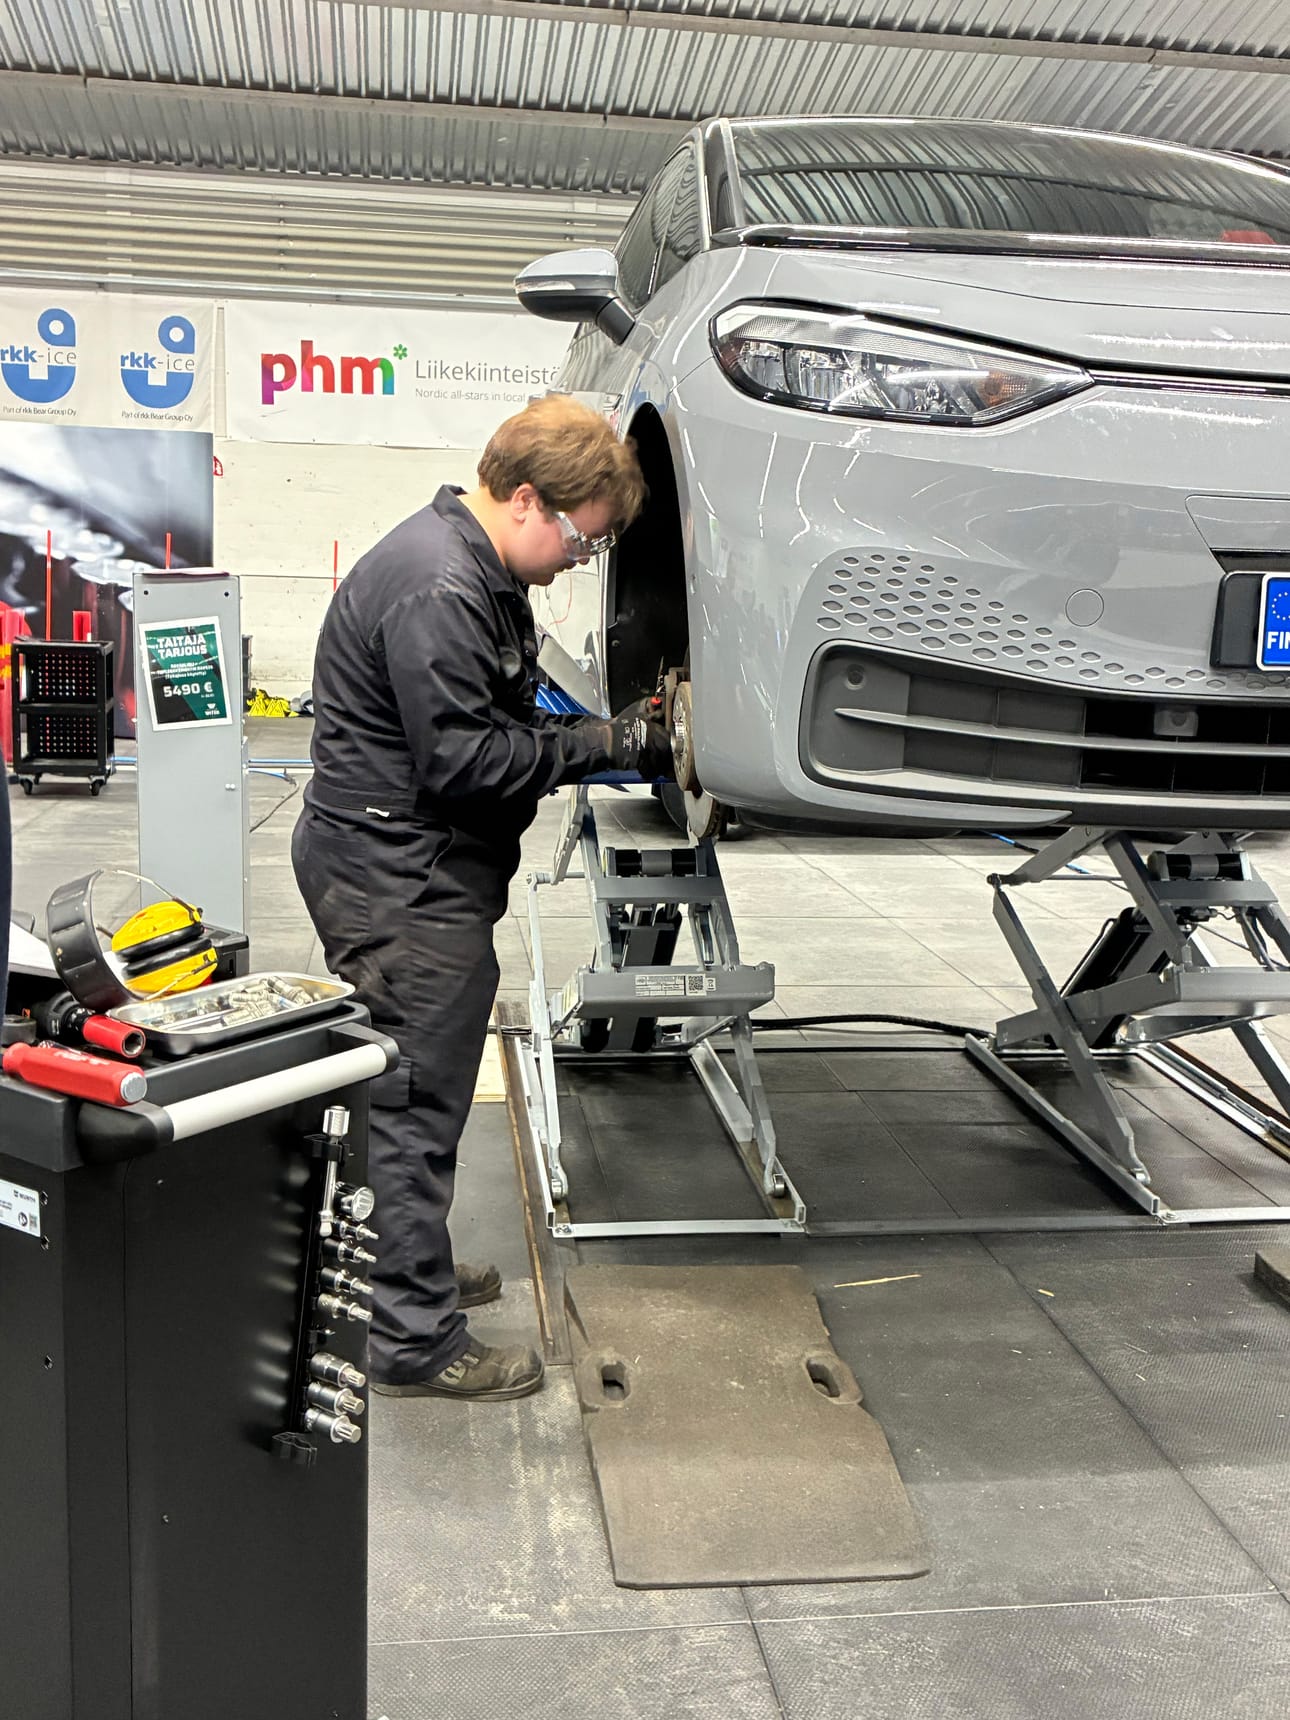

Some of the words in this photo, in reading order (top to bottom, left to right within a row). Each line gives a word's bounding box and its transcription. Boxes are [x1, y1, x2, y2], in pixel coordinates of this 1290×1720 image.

[0, 345, 77, 364] rkk-ice
[120, 352, 195, 371] rkk-ice
[261, 339, 394, 405] phm
[415, 388, 448, 399] Nordic
[450, 389, 489, 401] all-stars
[491, 391, 501, 401] in
[503, 392, 526, 403] local
[3, 406, 15, 414] Part
[15, 406, 22, 415] of
[47, 408, 67, 416] Group
[67, 408, 77, 417] Oy
[121, 411, 133, 419] Part
[133, 411, 140, 420] of
[164, 413, 184, 422] Group
[184, 414, 194, 423] Oy
[157, 634, 206, 649] TAITAJA
[158, 645, 207, 660] TARJOUS
[163, 683, 200, 698] 5490
[203, 681, 213, 693] €
